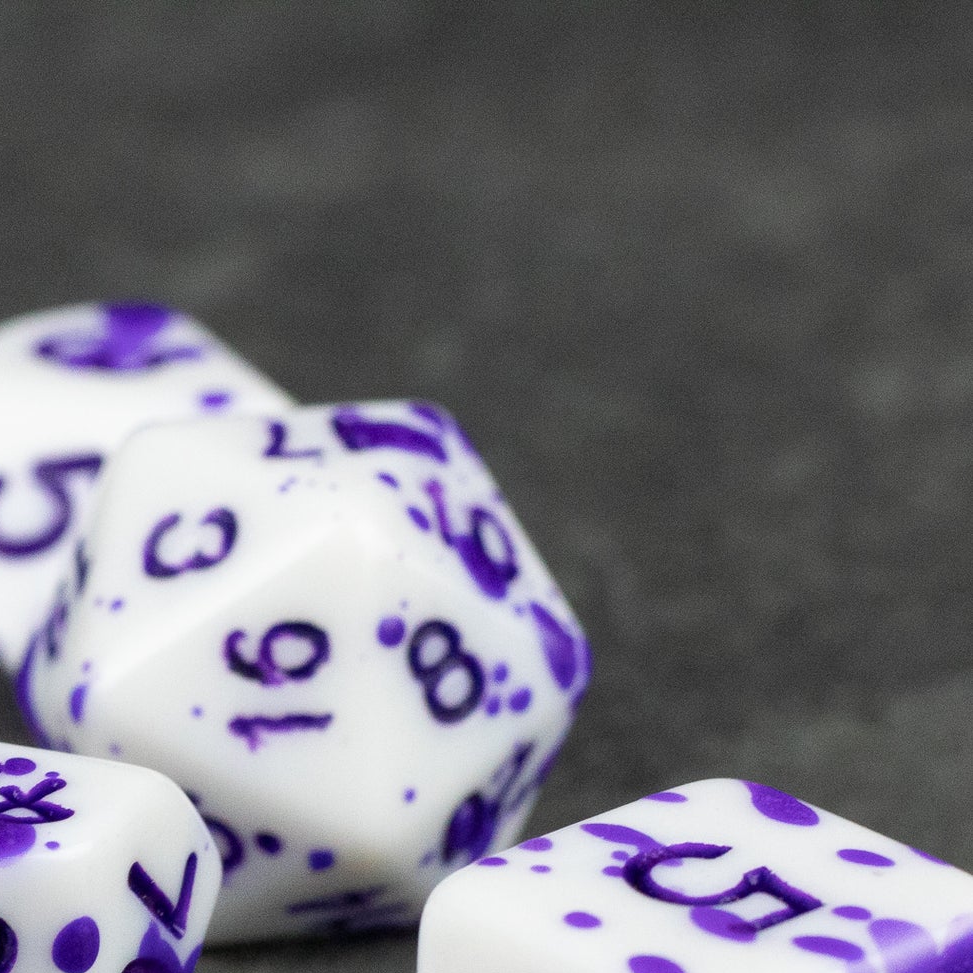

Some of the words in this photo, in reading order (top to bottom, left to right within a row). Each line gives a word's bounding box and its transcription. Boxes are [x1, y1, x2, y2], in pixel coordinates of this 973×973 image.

[141, 505, 239, 581] 3
[223, 618, 334, 747] 16
[407, 617, 487, 727] 8
[624, 841, 826, 933] 5
